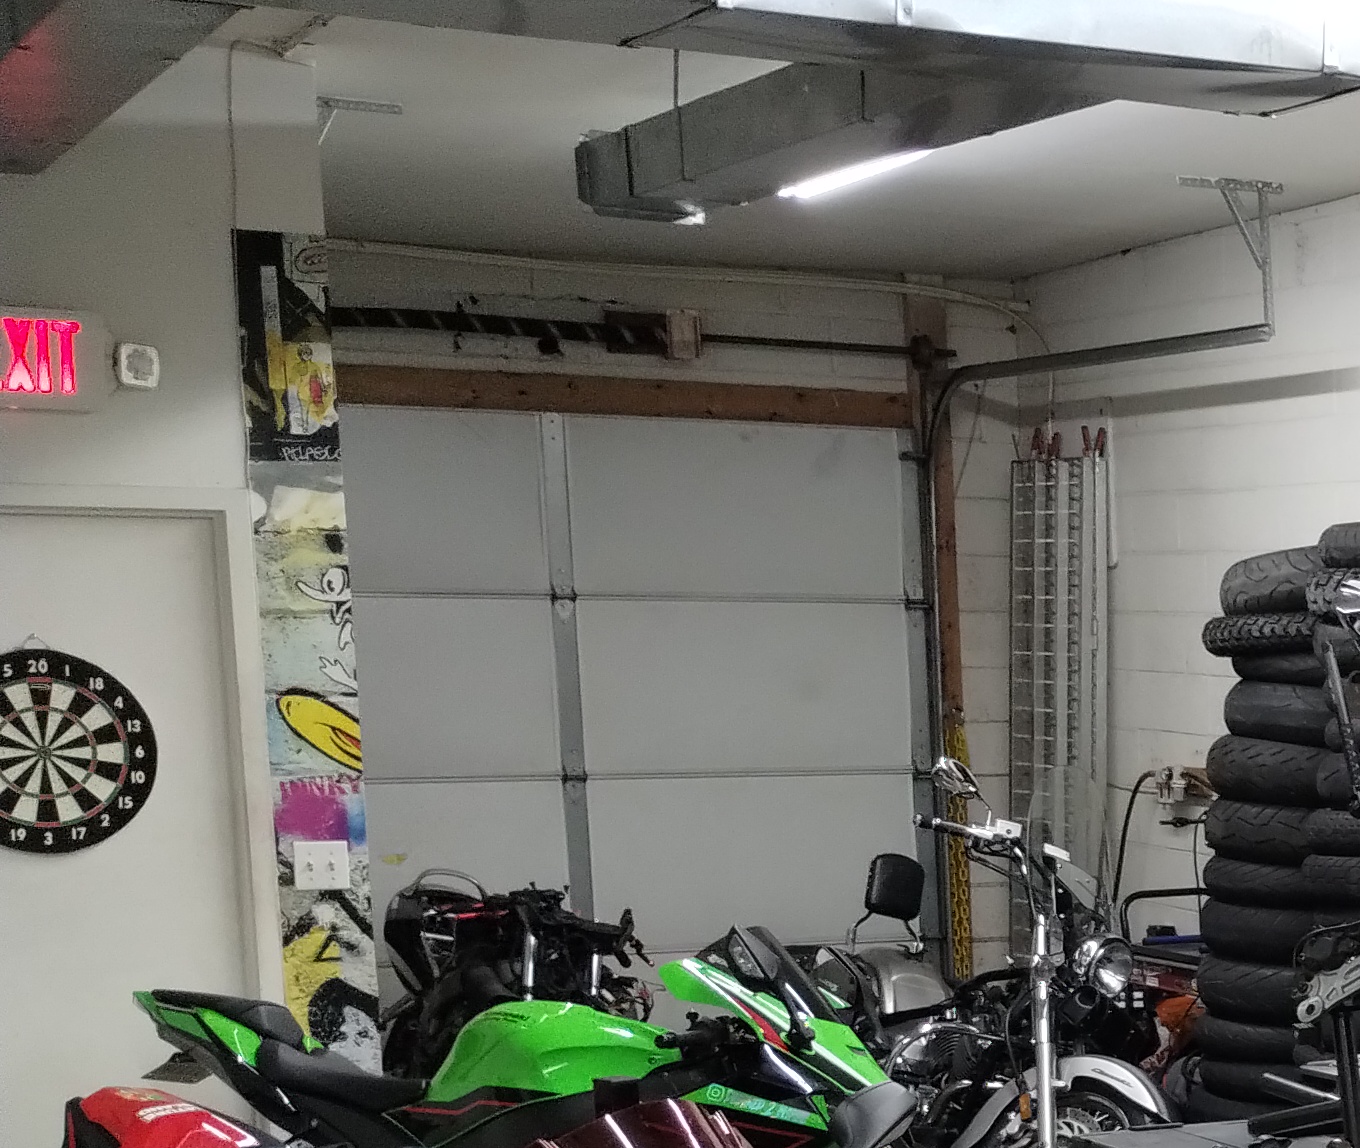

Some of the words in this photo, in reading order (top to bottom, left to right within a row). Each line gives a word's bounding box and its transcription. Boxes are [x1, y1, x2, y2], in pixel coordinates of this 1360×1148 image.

[0, 318, 80, 393] XIT
[3, 663, 13, 677] 5
[28, 659, 48, 673] 20
[65, 665, 70, 677] 1
[89, 677, 105, 690] 18
[114, 696, 124, 709] 4
[127, 719, 141, 732] 13
[135, 745, 145, 758] 6
[130, 770, 146, 783] 10
[118, 796, 134, 810] 15
[100, 814, 111, 827] 2
[9, 828, 27, 841] 19
[43, 831, 53, 845] 3
[71, 826, 87, 840] 17
